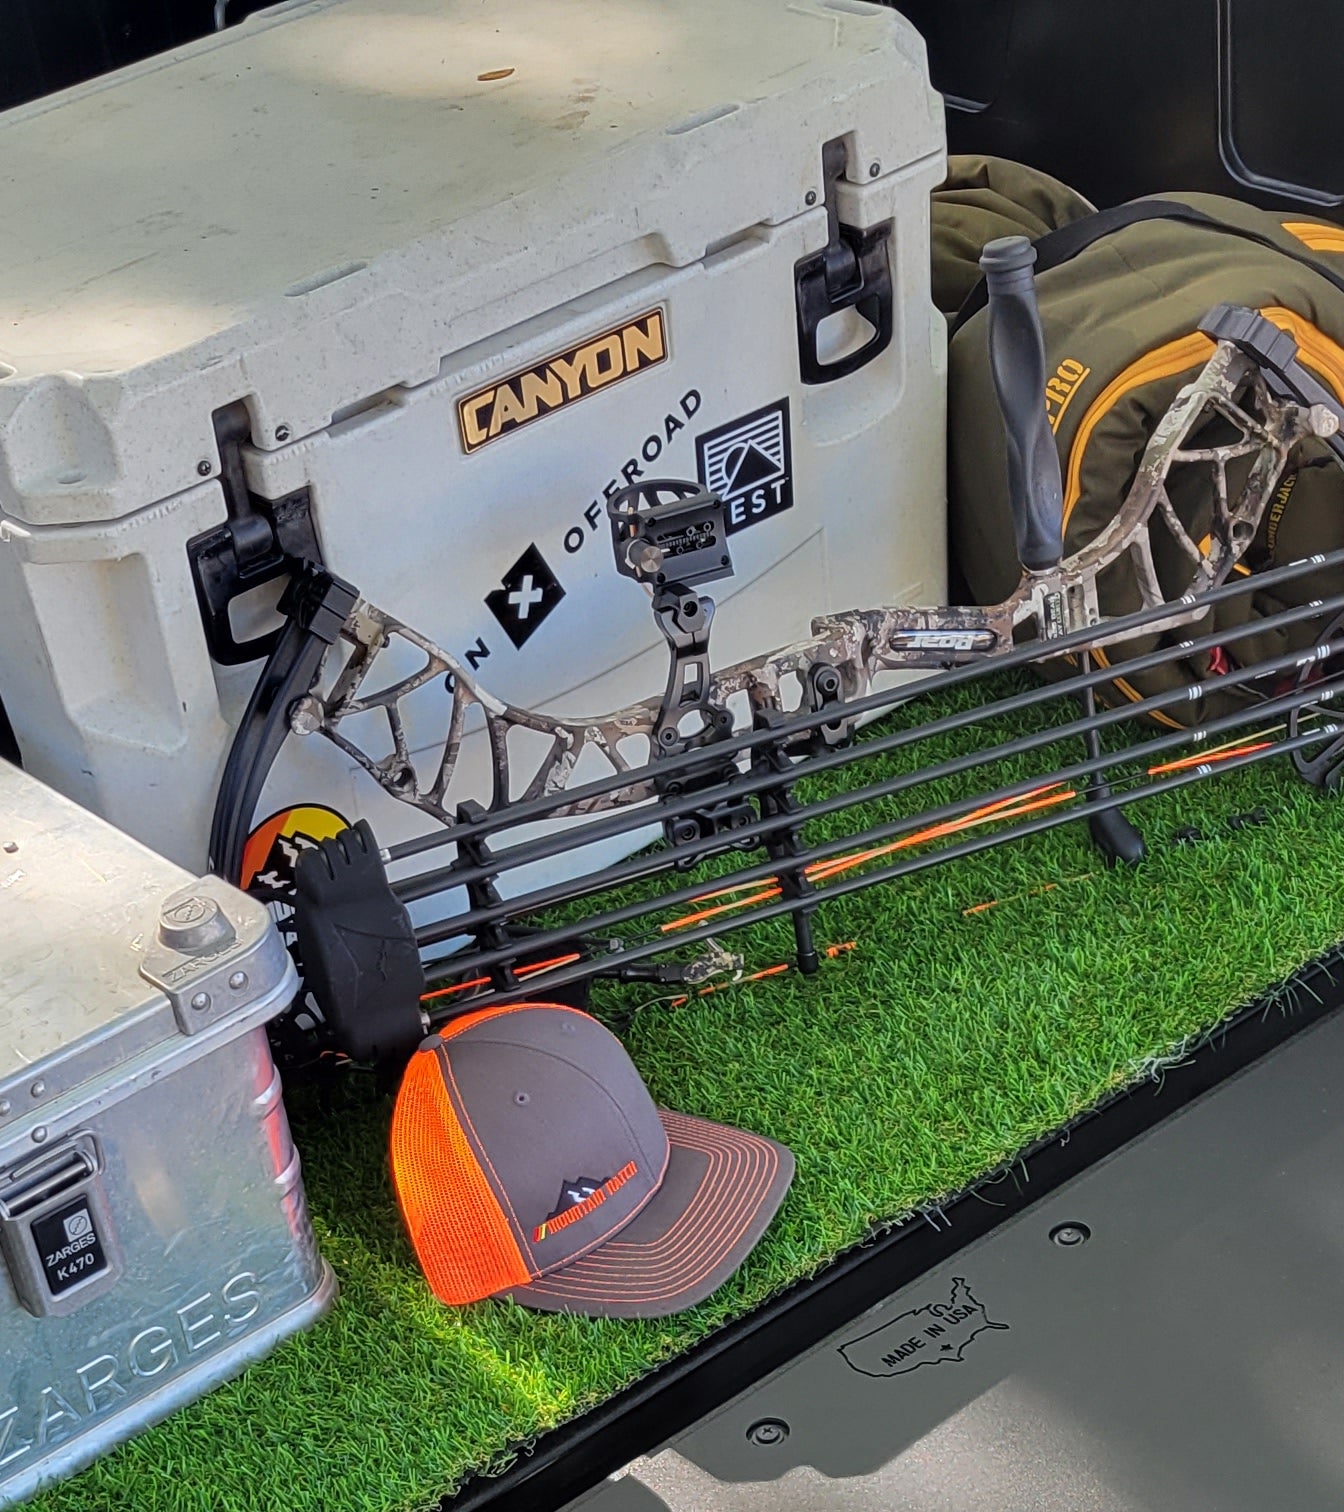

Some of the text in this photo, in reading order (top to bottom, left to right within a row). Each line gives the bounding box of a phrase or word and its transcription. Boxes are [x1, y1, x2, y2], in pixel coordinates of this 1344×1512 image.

[462, 313, 665, 446] CANYON
[563, 388, 702, 554] OFFROAD
[730, 480, 786, 525] EST
[546, 1188, 607, 1235] MOUNTAIN
[45, 1230, 97, 1269] ZARGES
[56, 1252, 96, 1283] K470
[881, 1303, 979, 1368] MADE IN USA
